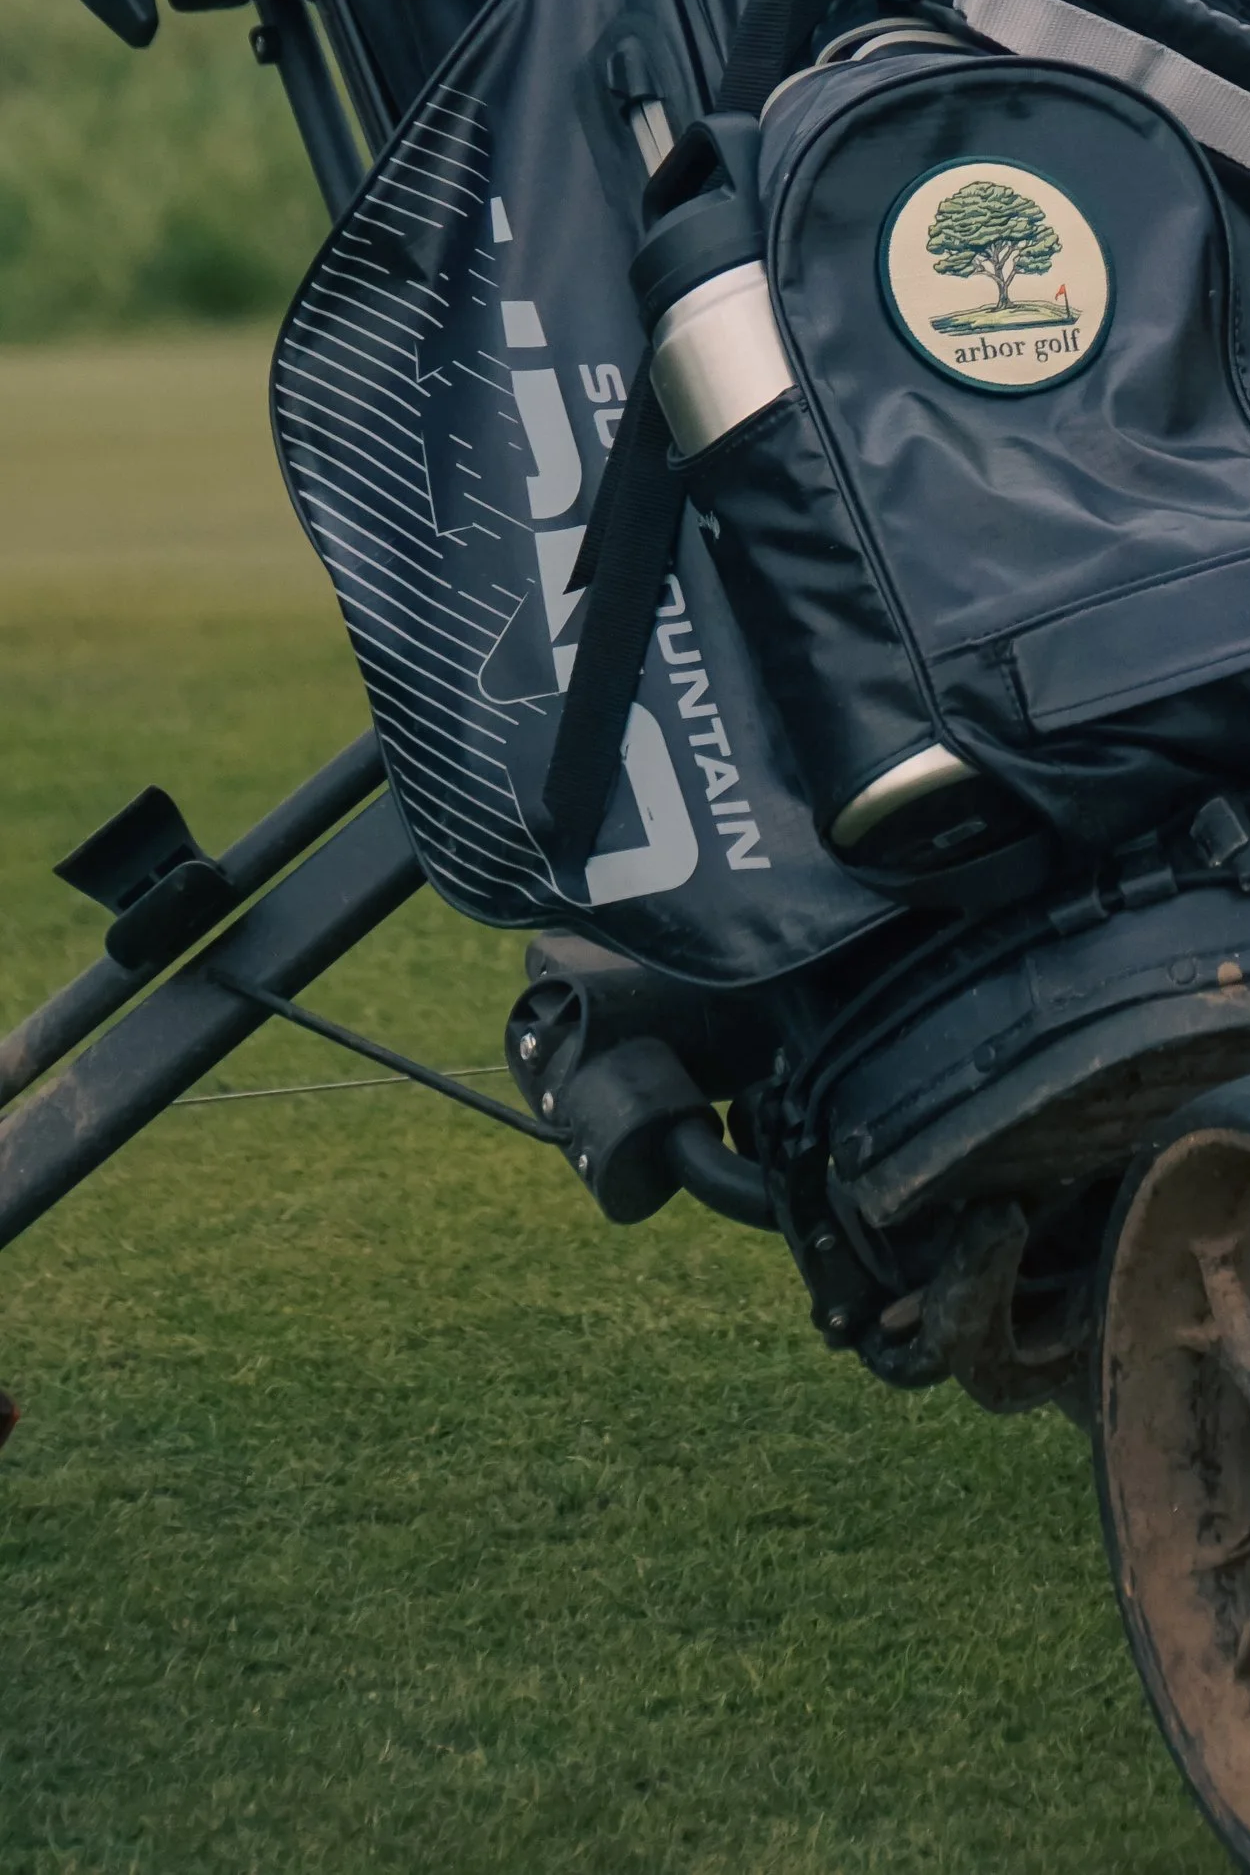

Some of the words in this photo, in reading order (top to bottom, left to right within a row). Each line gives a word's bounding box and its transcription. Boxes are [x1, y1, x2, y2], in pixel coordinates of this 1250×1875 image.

[955, 336, 1026, 364] arbor
[1034, 328, 1082, 362] golf
[578, 363, 628, 450] SU
[655, 573, 772, 870] OUNTAIN
